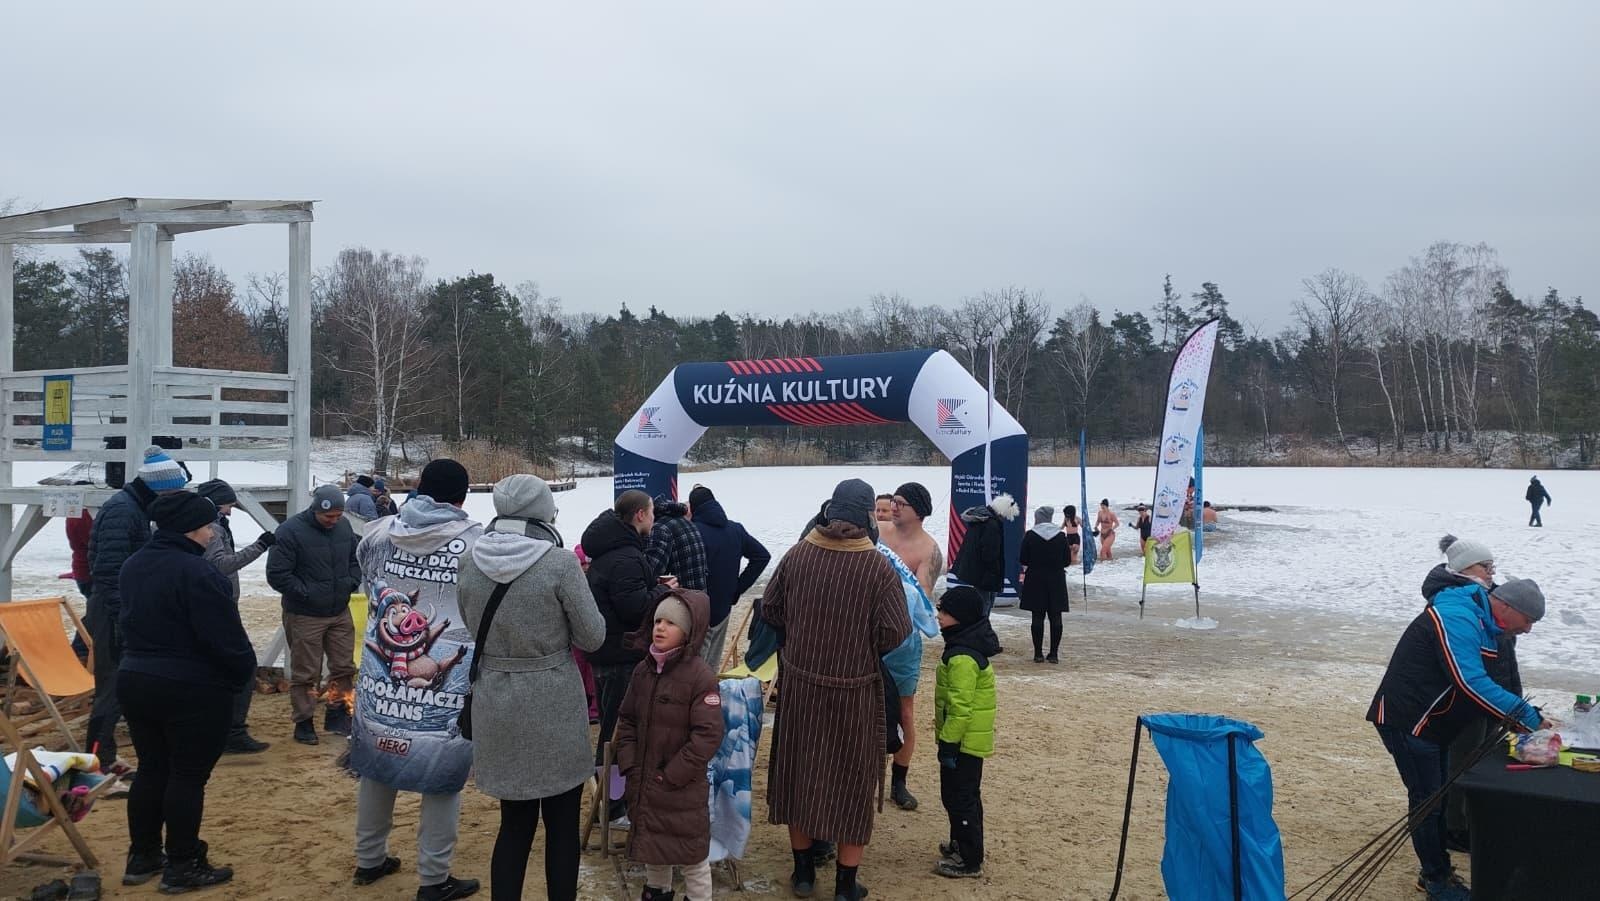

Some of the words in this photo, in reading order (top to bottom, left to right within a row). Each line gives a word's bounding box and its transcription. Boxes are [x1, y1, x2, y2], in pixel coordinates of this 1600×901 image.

[693, 377, 777, 404] KUŹNIA
[782, 376, 893, 402] KULTURY
[428, 554, 459, 569] DLA
[376, 699, 424, 721] HANS
[379, 738, 408, 753] HERO
